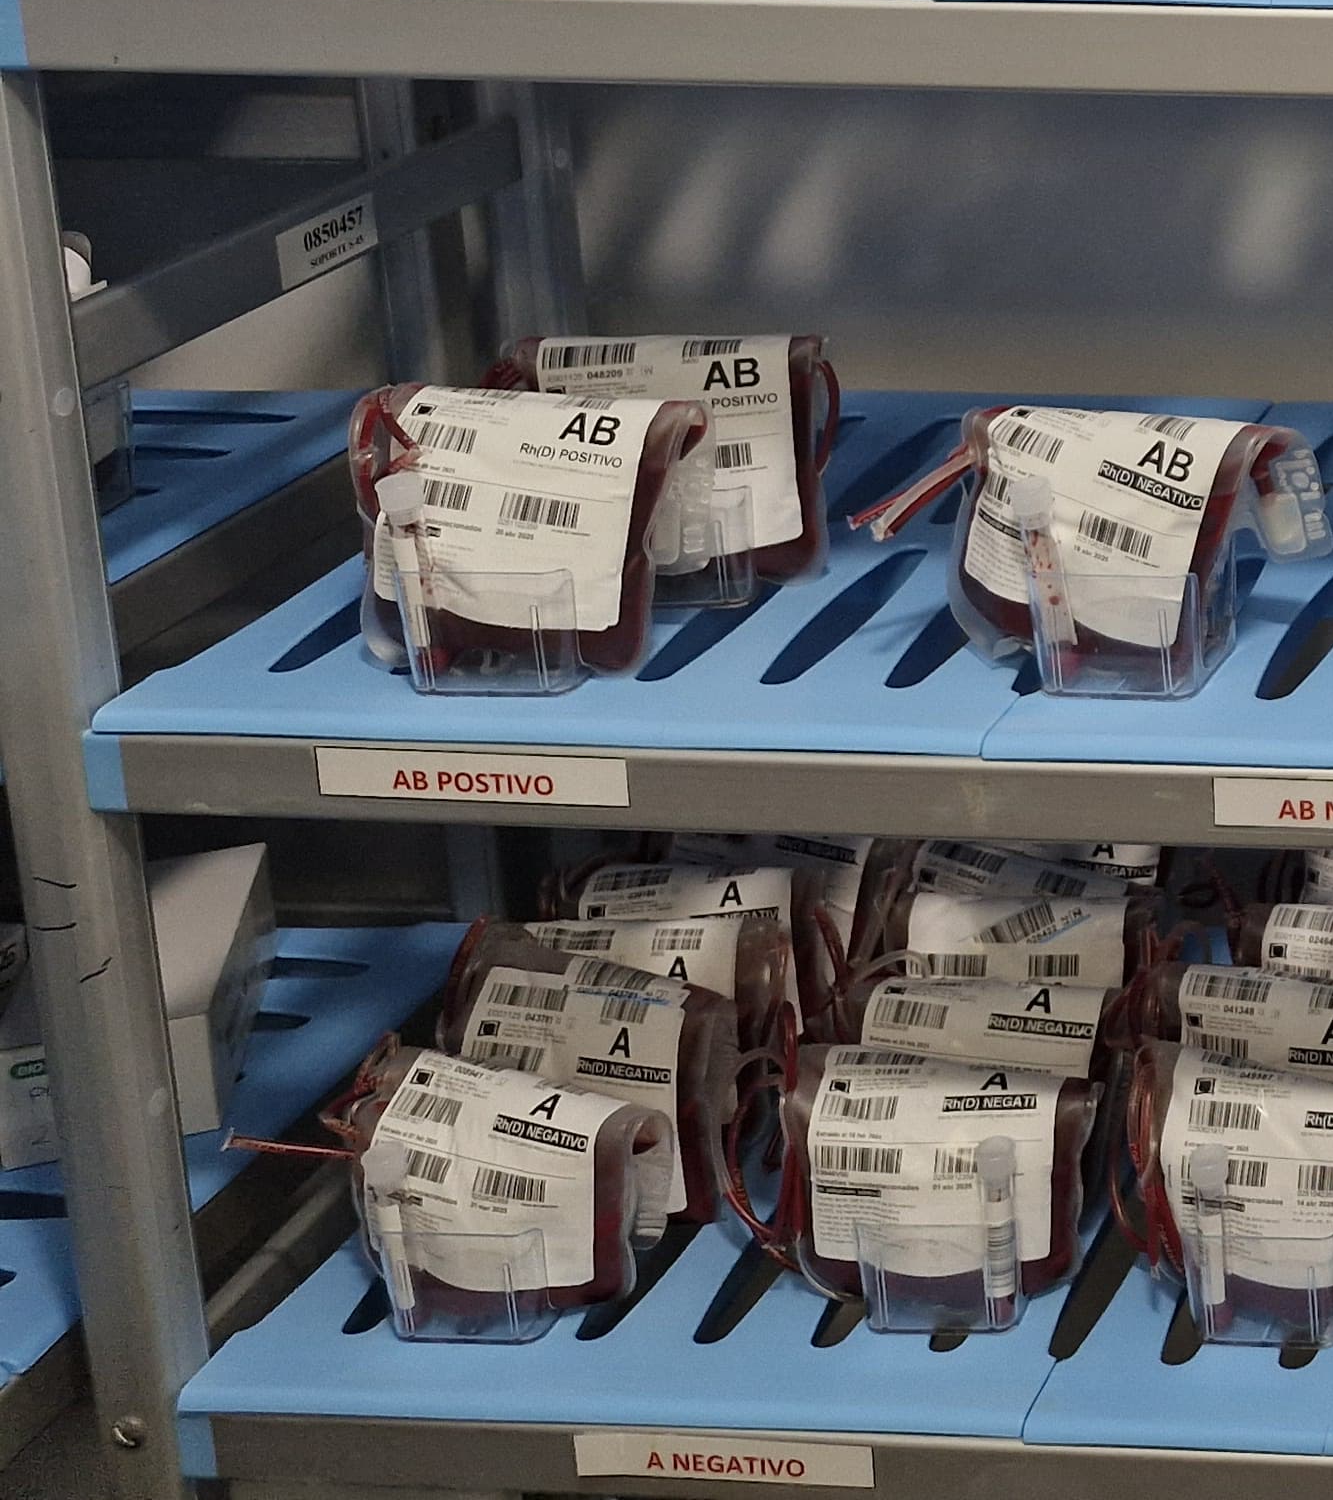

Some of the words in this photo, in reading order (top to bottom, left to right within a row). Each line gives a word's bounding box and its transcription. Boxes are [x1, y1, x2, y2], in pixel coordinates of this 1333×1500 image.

[303, 205, 362, 252] 0850457
[703, 358, 761, 391] AB
[711, 392, 778, 409] POSITIVO
[559, 411, 621, 446] AB
[519, 443, 556, 461] Rh(D)
[559, 448, 623, 469] POSITIVO
[1137, 440, 1195, 482] AB
[1099, 460, 1134, 487] Rh(D)
[1136, 476, 1204, 509] NEGATIVO
[393, 770, 428, 791] AB
[438, 771, 553, 795] POSTIVO
[1279, 800, 1315, 820] AB
[720, 881, 743, 908] A
[1025, 988, 1052, 1013] A
[988, 1014, 1024, 1031] Rh(D)
[1025, 1020, 1095, 1038] NEGATIVO
[608, 1027, 631, 1059] A
[1288, 1050, 1323, 1064] Rh(D)
[577, 1059, 607, 1076] Rh(D)
[609, 1064, 671, 1083] NEGATIVO
[980, 1072, 1009, 1090] A
[528, 1094, 562, 1121] A
[943, 1097, 980, 1111] Rh(D)
[493, 1115, 525, 1137] Rh(D)
[527, 1124, 588, 1151] NEGATIVO
[647, 1452, 664, 1470] A
[673, 1453, 805, 1477] NEGATIVO
